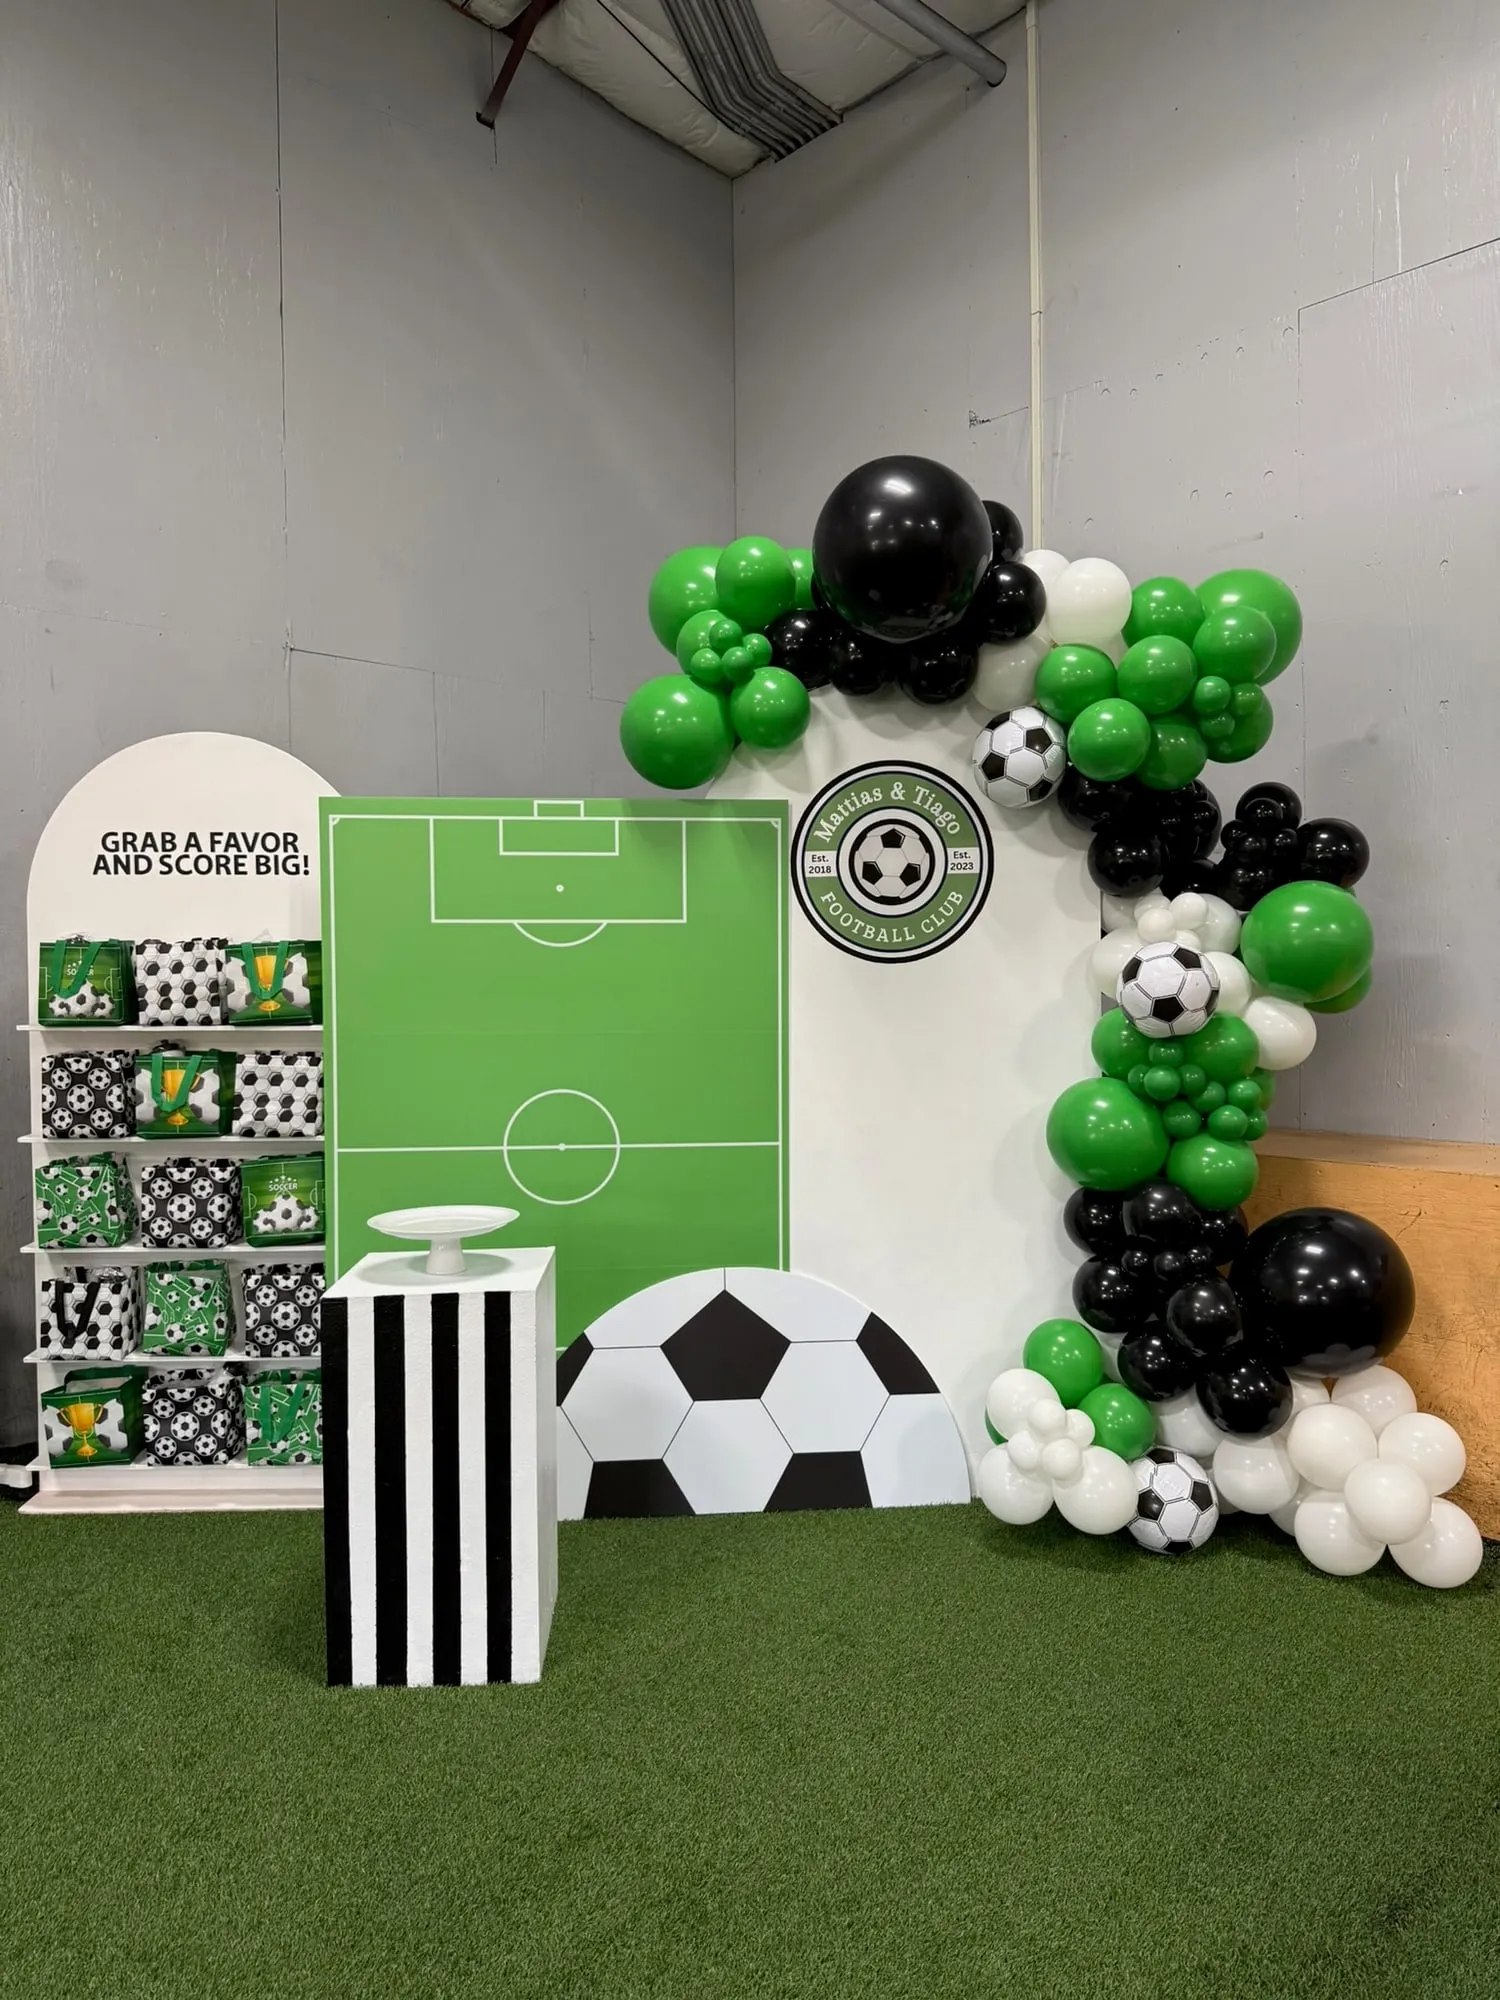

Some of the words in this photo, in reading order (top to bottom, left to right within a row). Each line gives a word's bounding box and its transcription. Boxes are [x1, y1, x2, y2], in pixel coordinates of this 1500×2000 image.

[813, 788, 883, 843] Mattias
[890, 781, 906, 801] &
[912, 786, 961, 835] Tiago
[101, 832, 177, 853] GRAB
[183, 832, 202, 852] A
[209, 832, 299, 853] FAVOR
[811, 854, 830, 863] Est.
[953, 850, 972, 860] Est.
[92, 854, 153, 875] AND
[159, 854, 248, 875] SCORE
[255, 854, 310, 876] BIG!
[808, 865, 832, 874] 2018
[950, 862, 974, 871] 2023
[820, 891, 916, 943] FOOTBALL
[921, 891, 963, 934] CLUB
[67, 968, 94, 976] SOR
[268, 1183, 298, 1192] SOCCER
